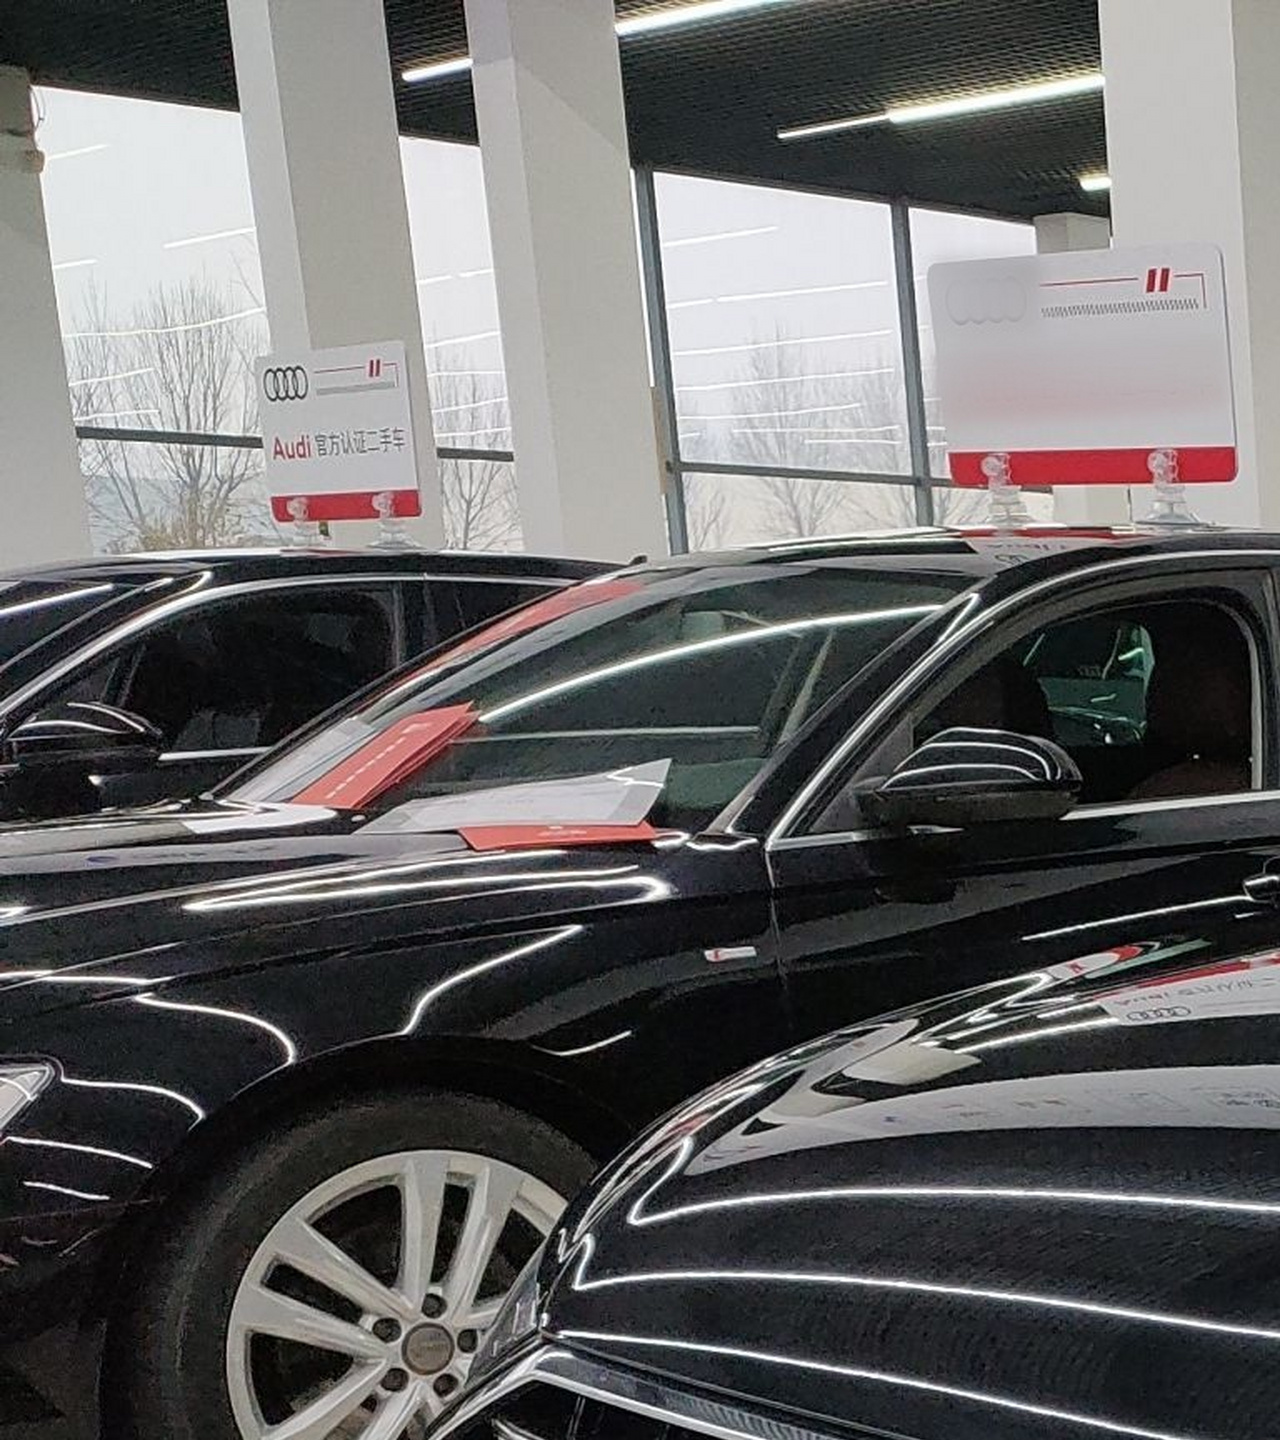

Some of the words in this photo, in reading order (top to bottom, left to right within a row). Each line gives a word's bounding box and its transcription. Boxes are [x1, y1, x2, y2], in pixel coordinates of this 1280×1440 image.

[272, 434, 312, 460] Audi
[315, 427, 405, 456] 官方认证二手车
